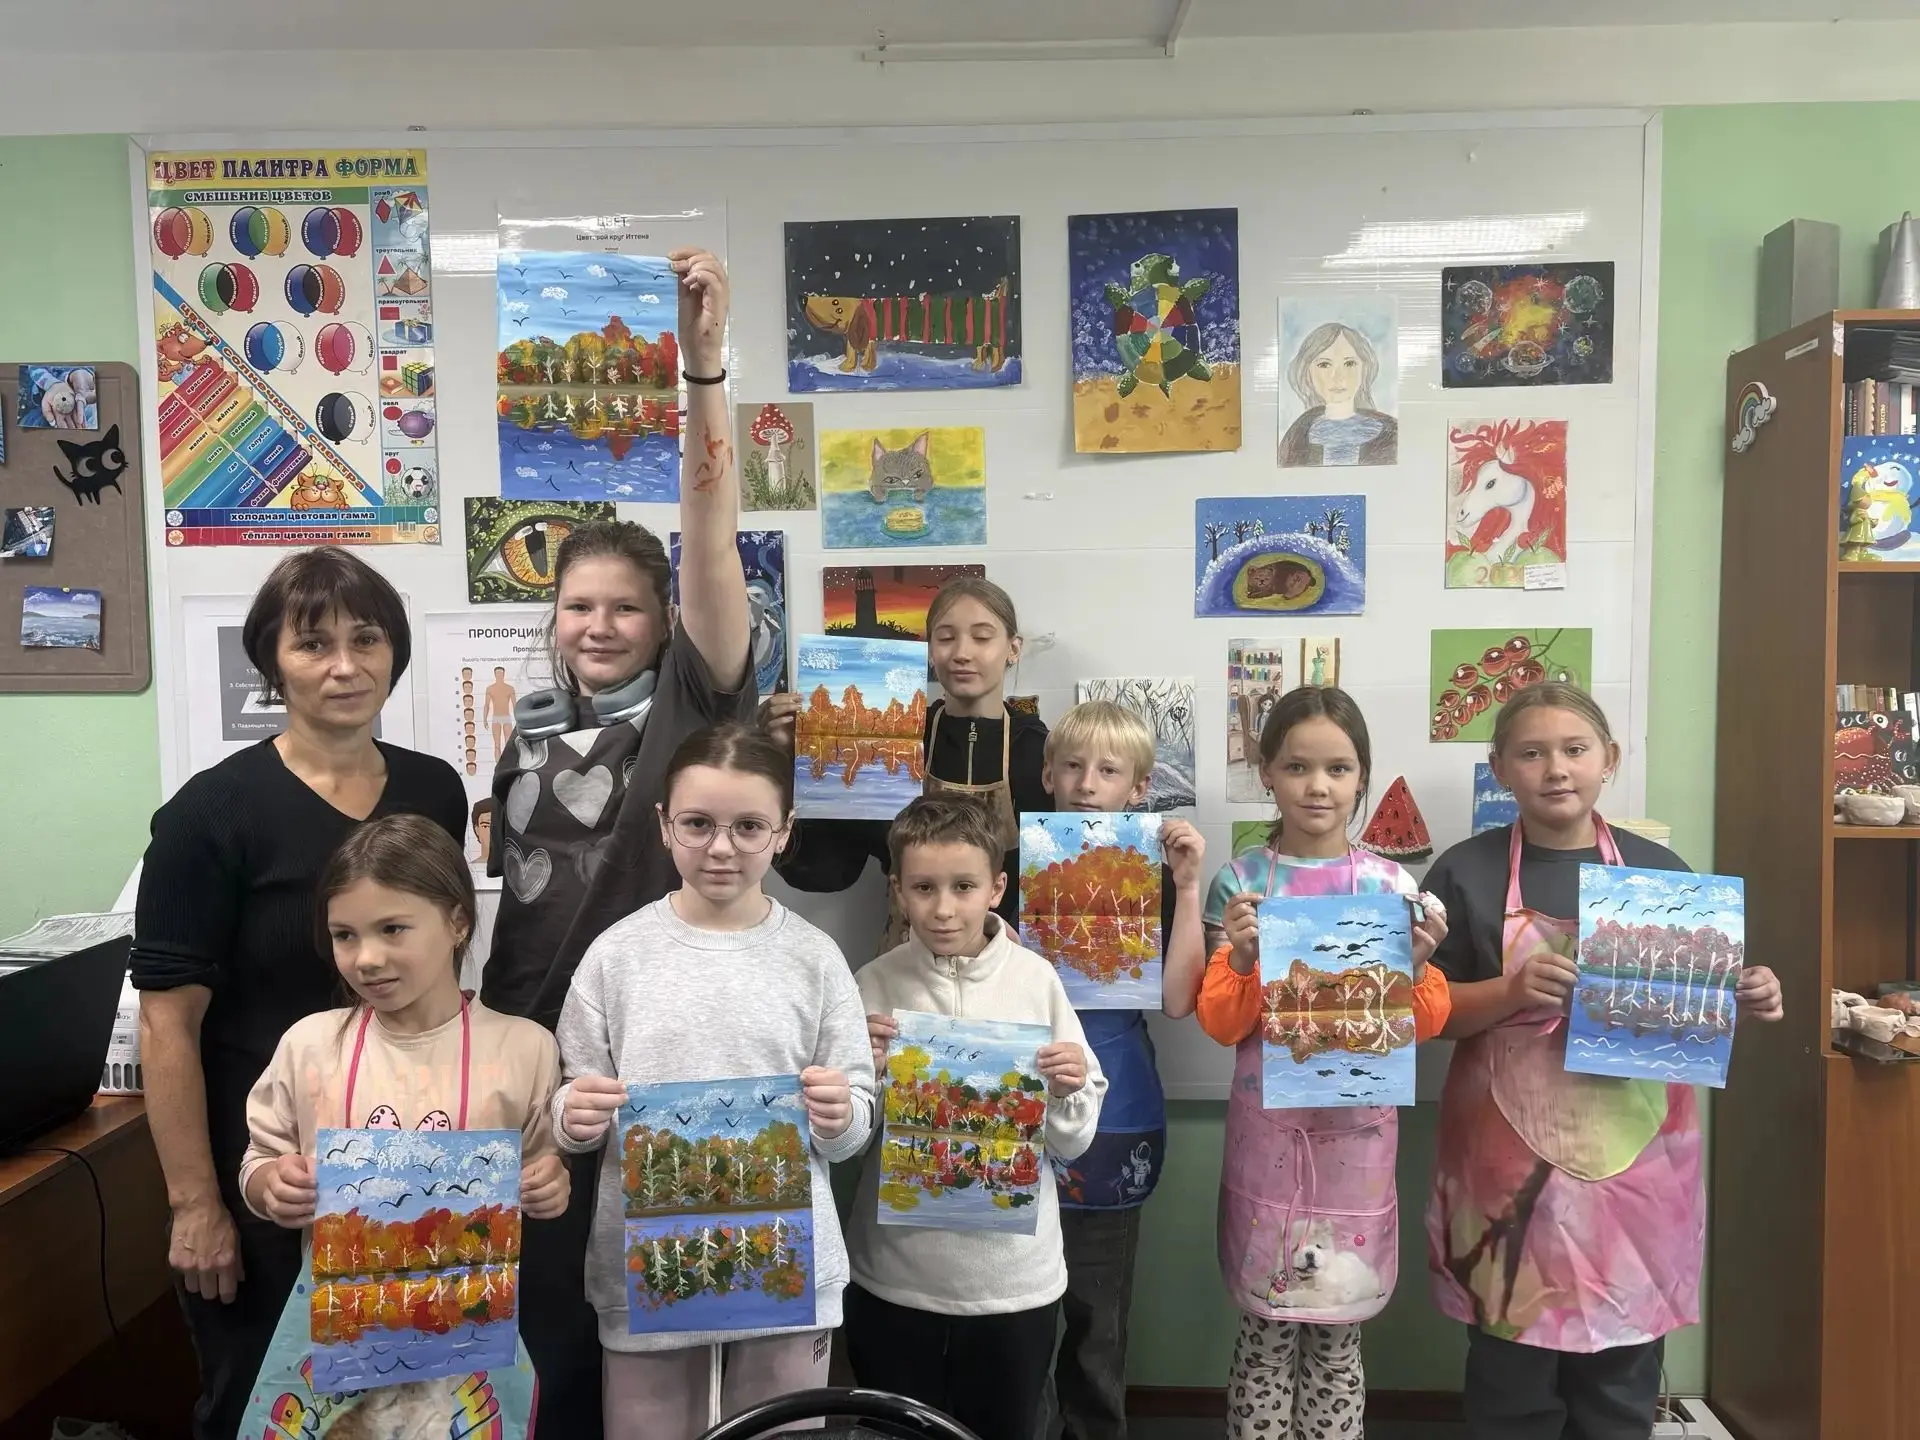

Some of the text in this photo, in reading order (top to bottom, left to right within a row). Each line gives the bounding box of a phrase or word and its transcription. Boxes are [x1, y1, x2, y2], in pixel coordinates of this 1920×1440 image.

[154, 158, 418, 184] ЦВЕТ ПАЛИТРА ФОРМА
[185, 191, 332, 203] СМЕШЕНИЕ ЦВЕТОВ
[186, 369, 213, 394] красный
[180, 303, 365, 490] цвета солнечного спектра
[198, 379, 231, 412] оранжевый
[216, 400, 239, 423] жёлтый
[171, 416, 194, 438] охотник
[231, 411, 257, 437] зелёный
[189, 431, 208, 452] желает
[248, 427, 272, 450] голубой
[207, 446, 223, 462] знать
[264, 446, 283, 464] синий
[272, 451, 307, 486] фиолетовый
[239, 476, 256, 493] сидит
[251, 488, 269, 507] фазан
[231, 511, 376, 523] холодная цветовая гамма
[242, 530, 371, 541] тёплая цветовая гамма
